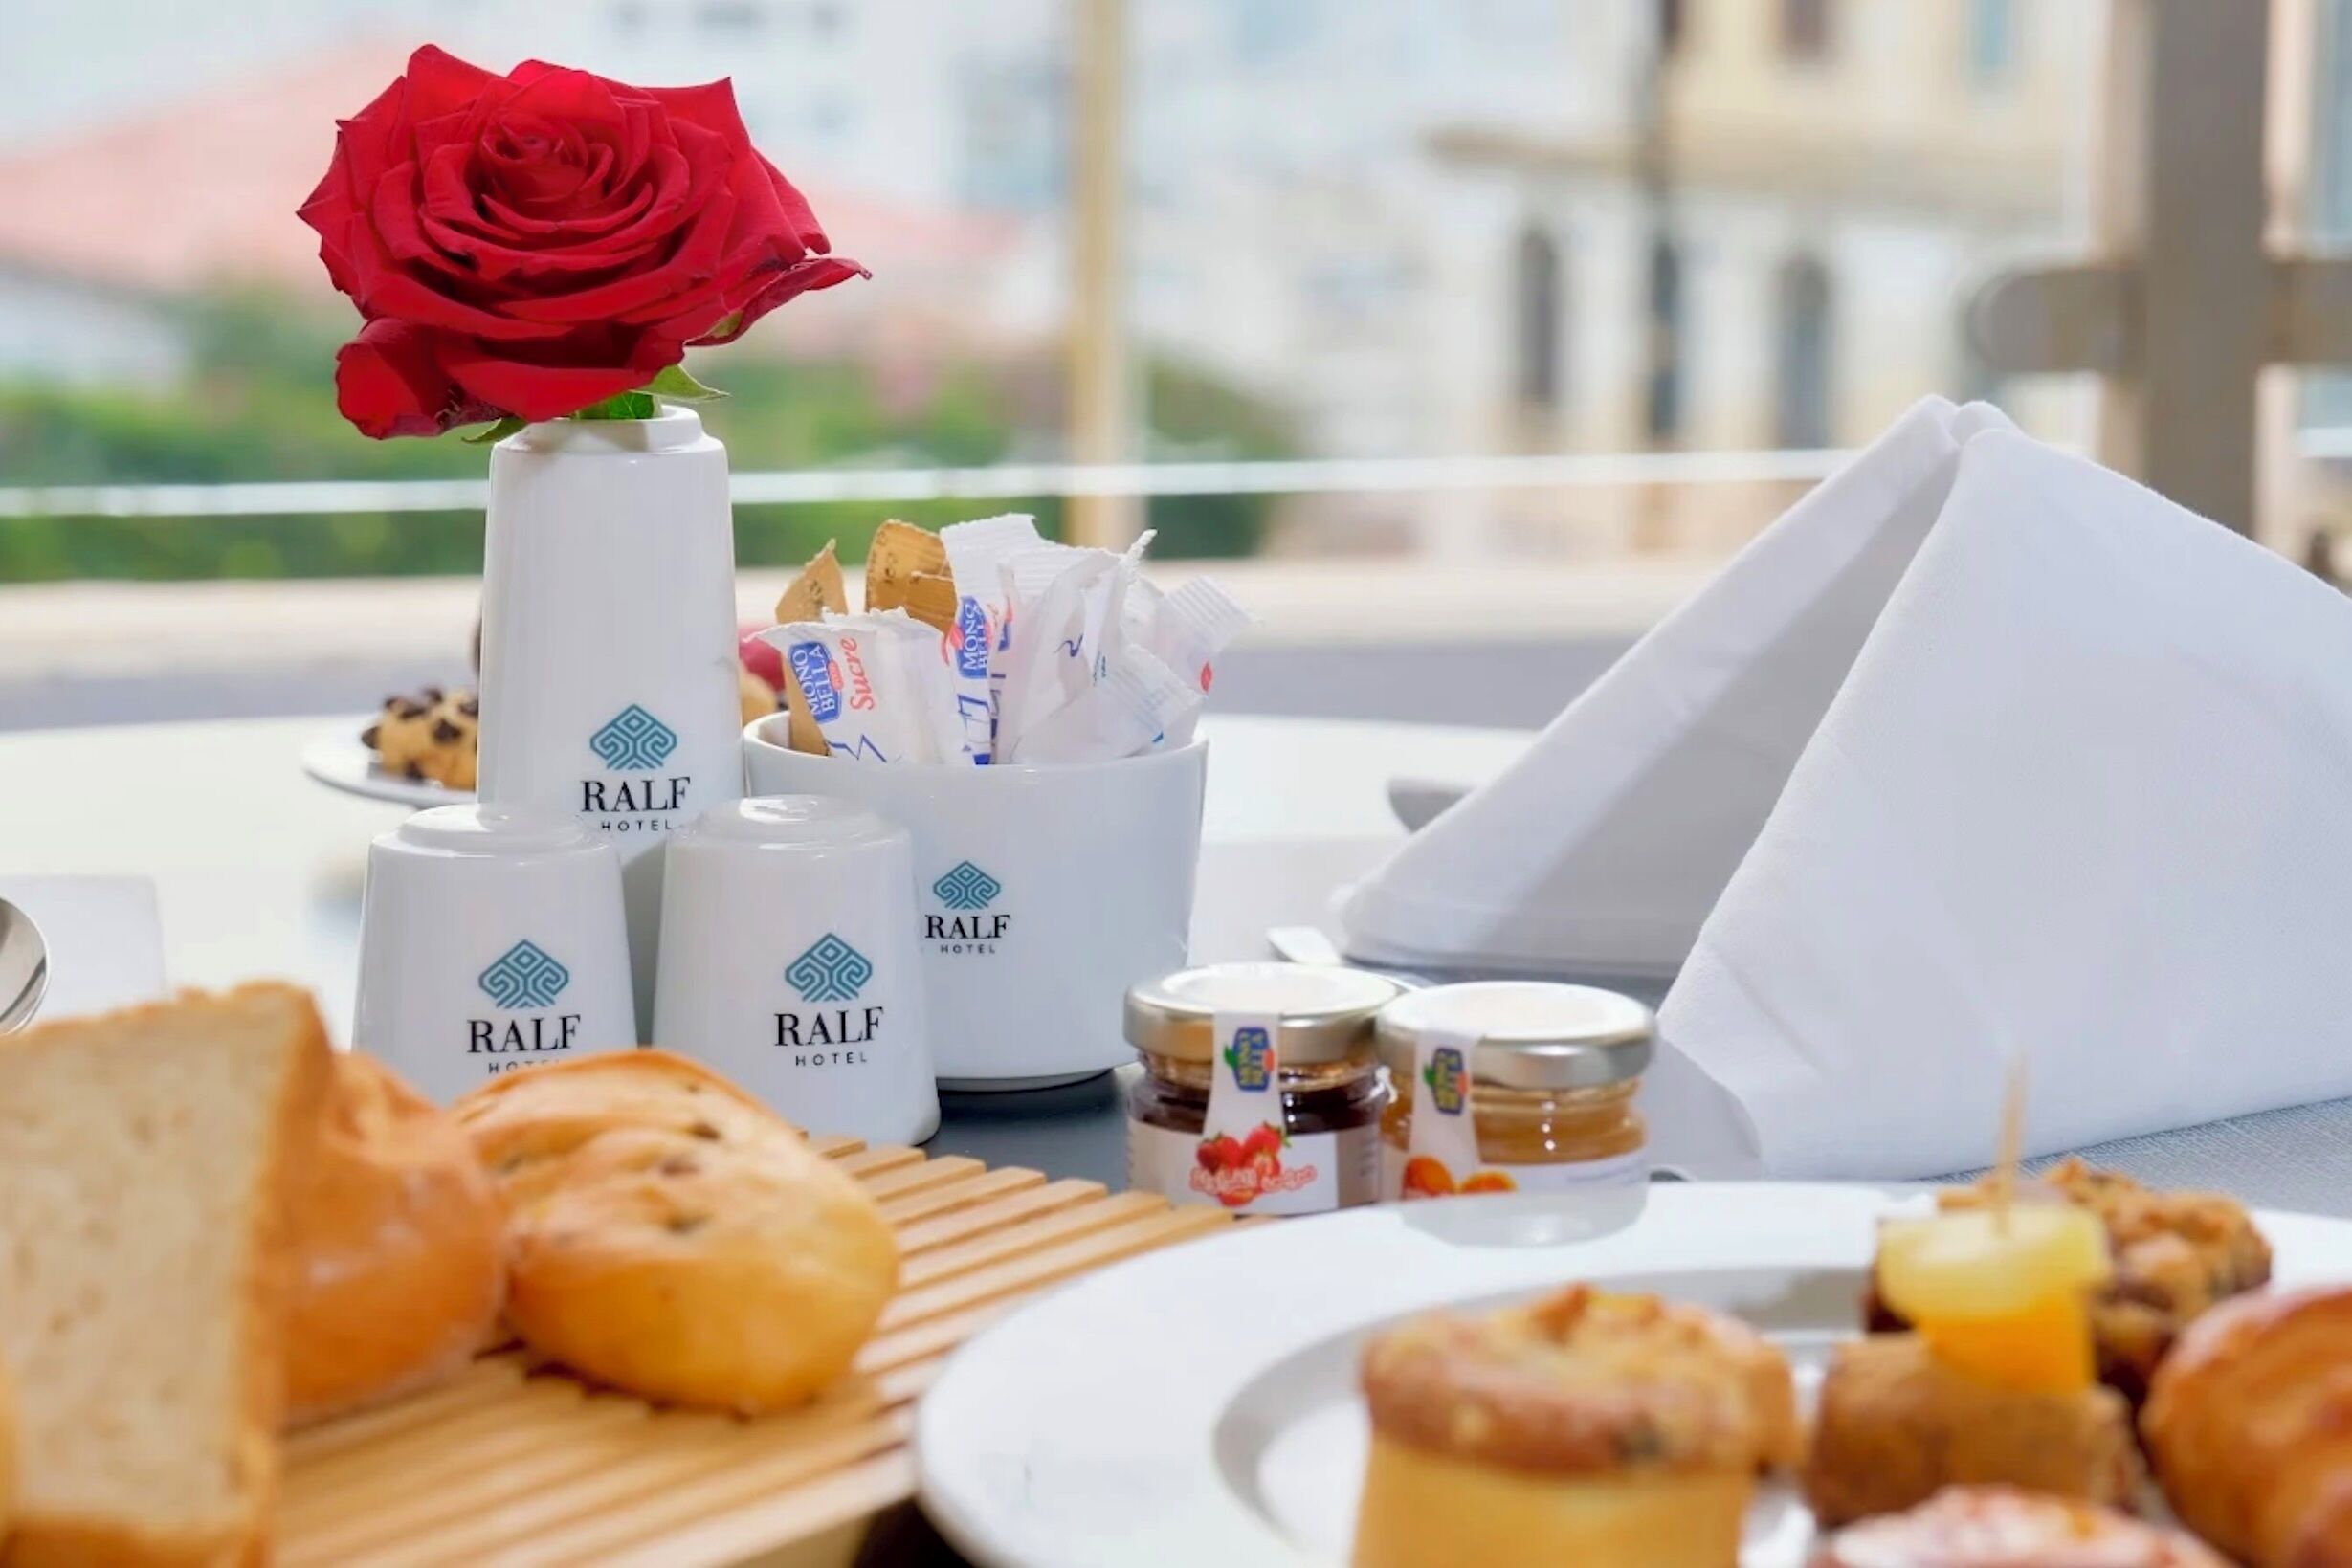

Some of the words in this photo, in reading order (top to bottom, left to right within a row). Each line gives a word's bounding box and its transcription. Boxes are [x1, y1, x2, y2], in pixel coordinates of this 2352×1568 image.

[792, 650, 822, 715] MONO
[809, 645, 835, 712] BELLA
[840, 636, 875, 711] Sucre
[580, 776, 691, 812] RALF
[601, 819, 672, 832] HOTEL
[925, 914, 1011, 939] RALF
[940, 943, 996, 955] HOTEL
[466, 1014, 582, 1054] RALF
[773, 1006, 884, 1047] RALF
[794, 1050, 868, 1068] HOTEL
